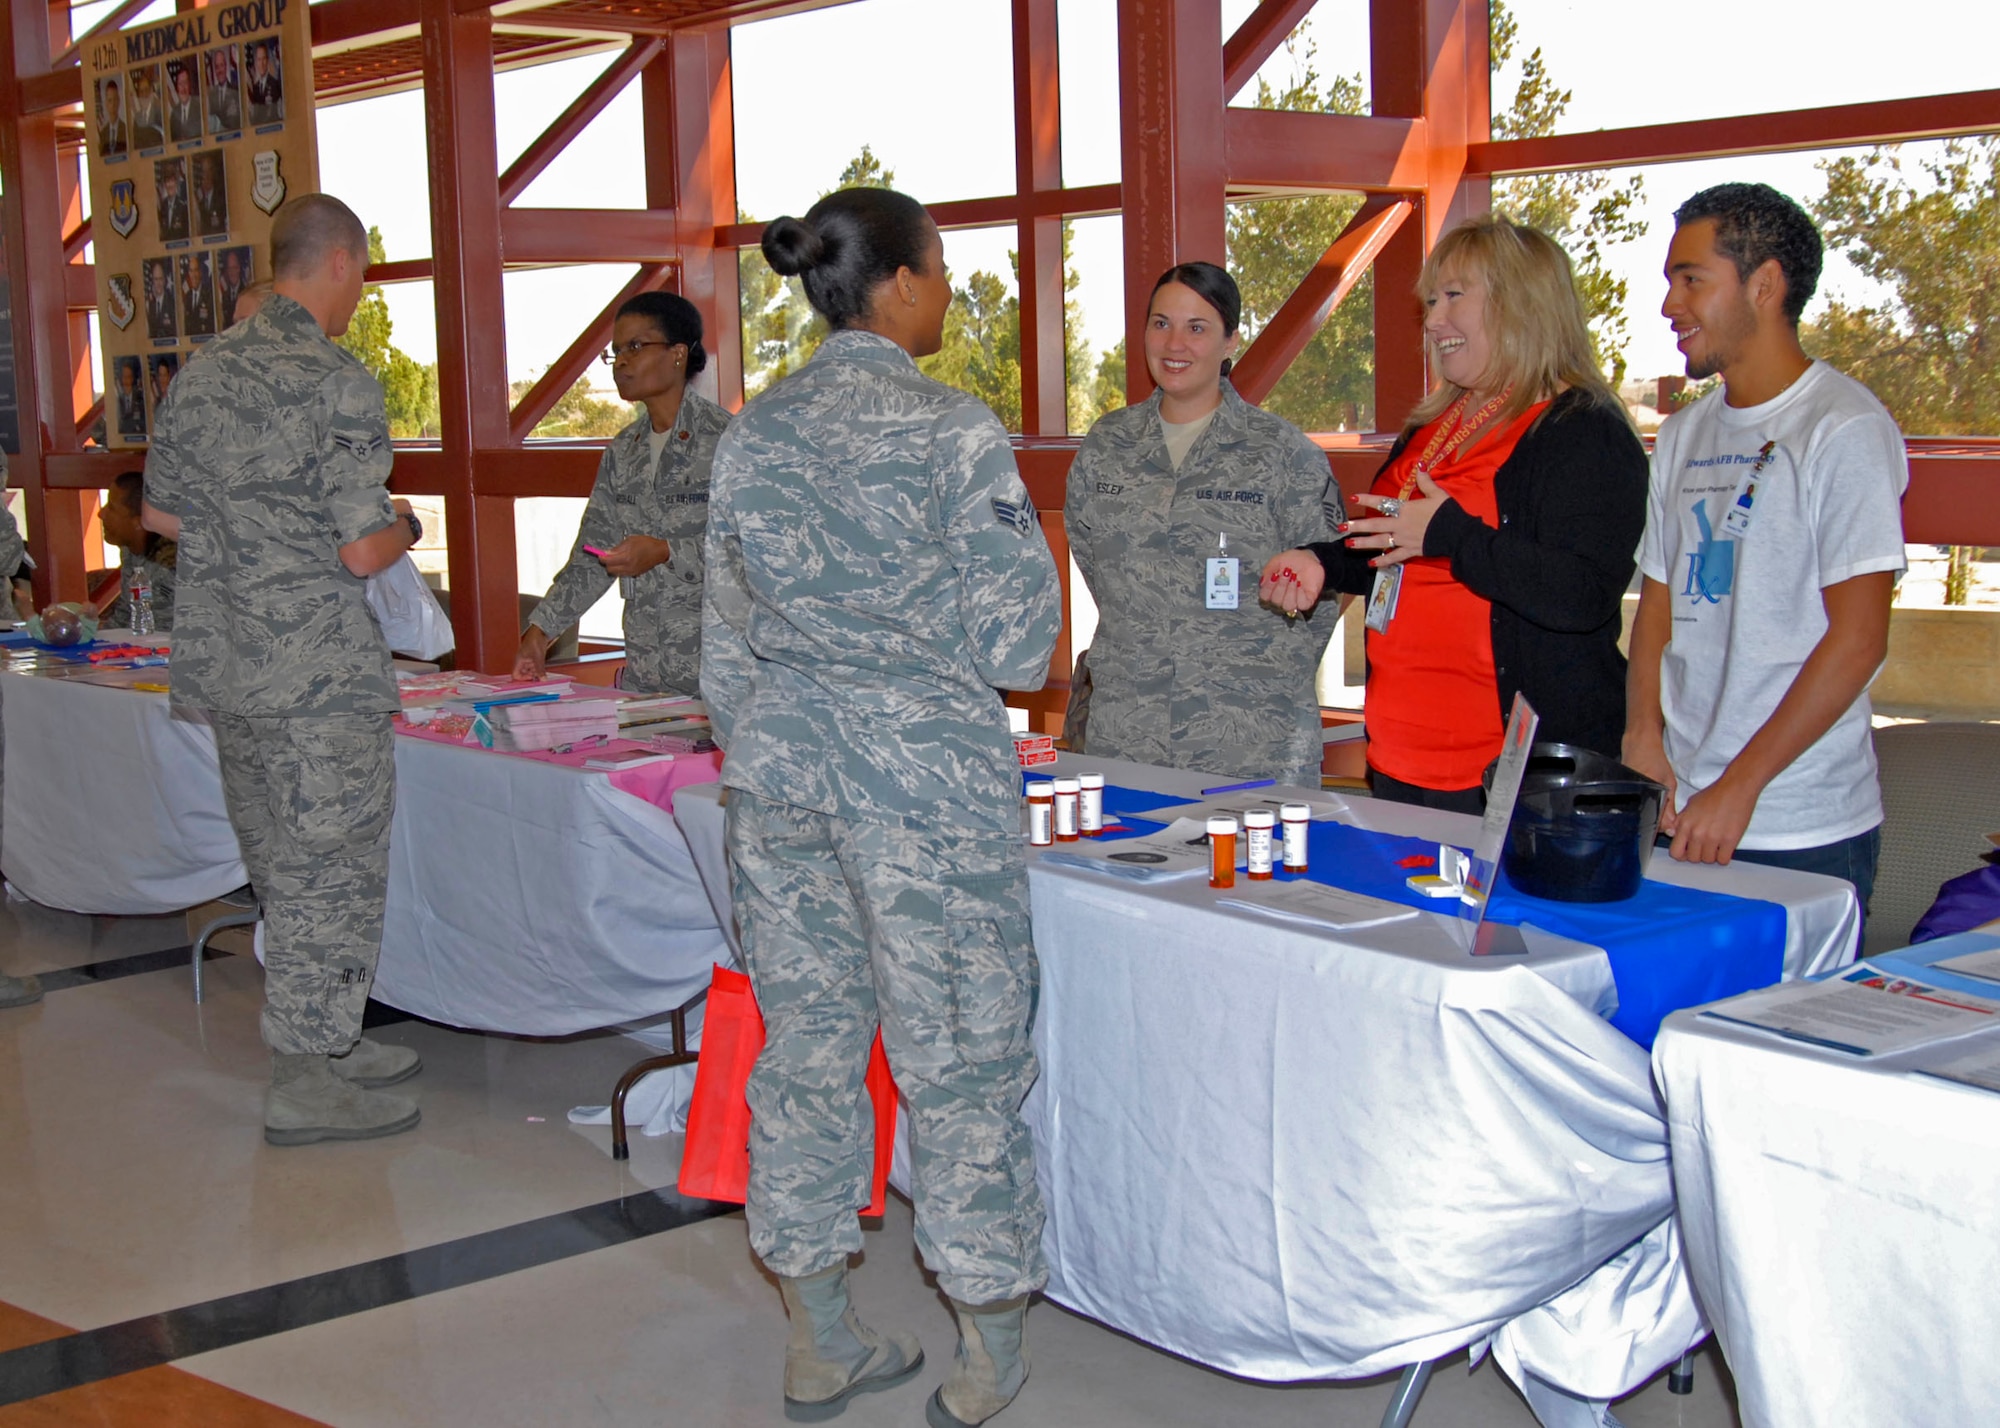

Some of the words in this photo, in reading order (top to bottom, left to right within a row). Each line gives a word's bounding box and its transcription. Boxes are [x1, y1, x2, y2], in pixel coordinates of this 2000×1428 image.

[93, 42, 118, 71] 412th
[125, 15, 211, 63] MEDICAL
[218, 0, 287, 39] GROUP
[1444, 407, 1490, 456] MARINE
[1196, 489, 1214, 500] U.S.
[1216, 490, 1232, 501] AIR
[1234, 490, 1264, 505] FORCE
